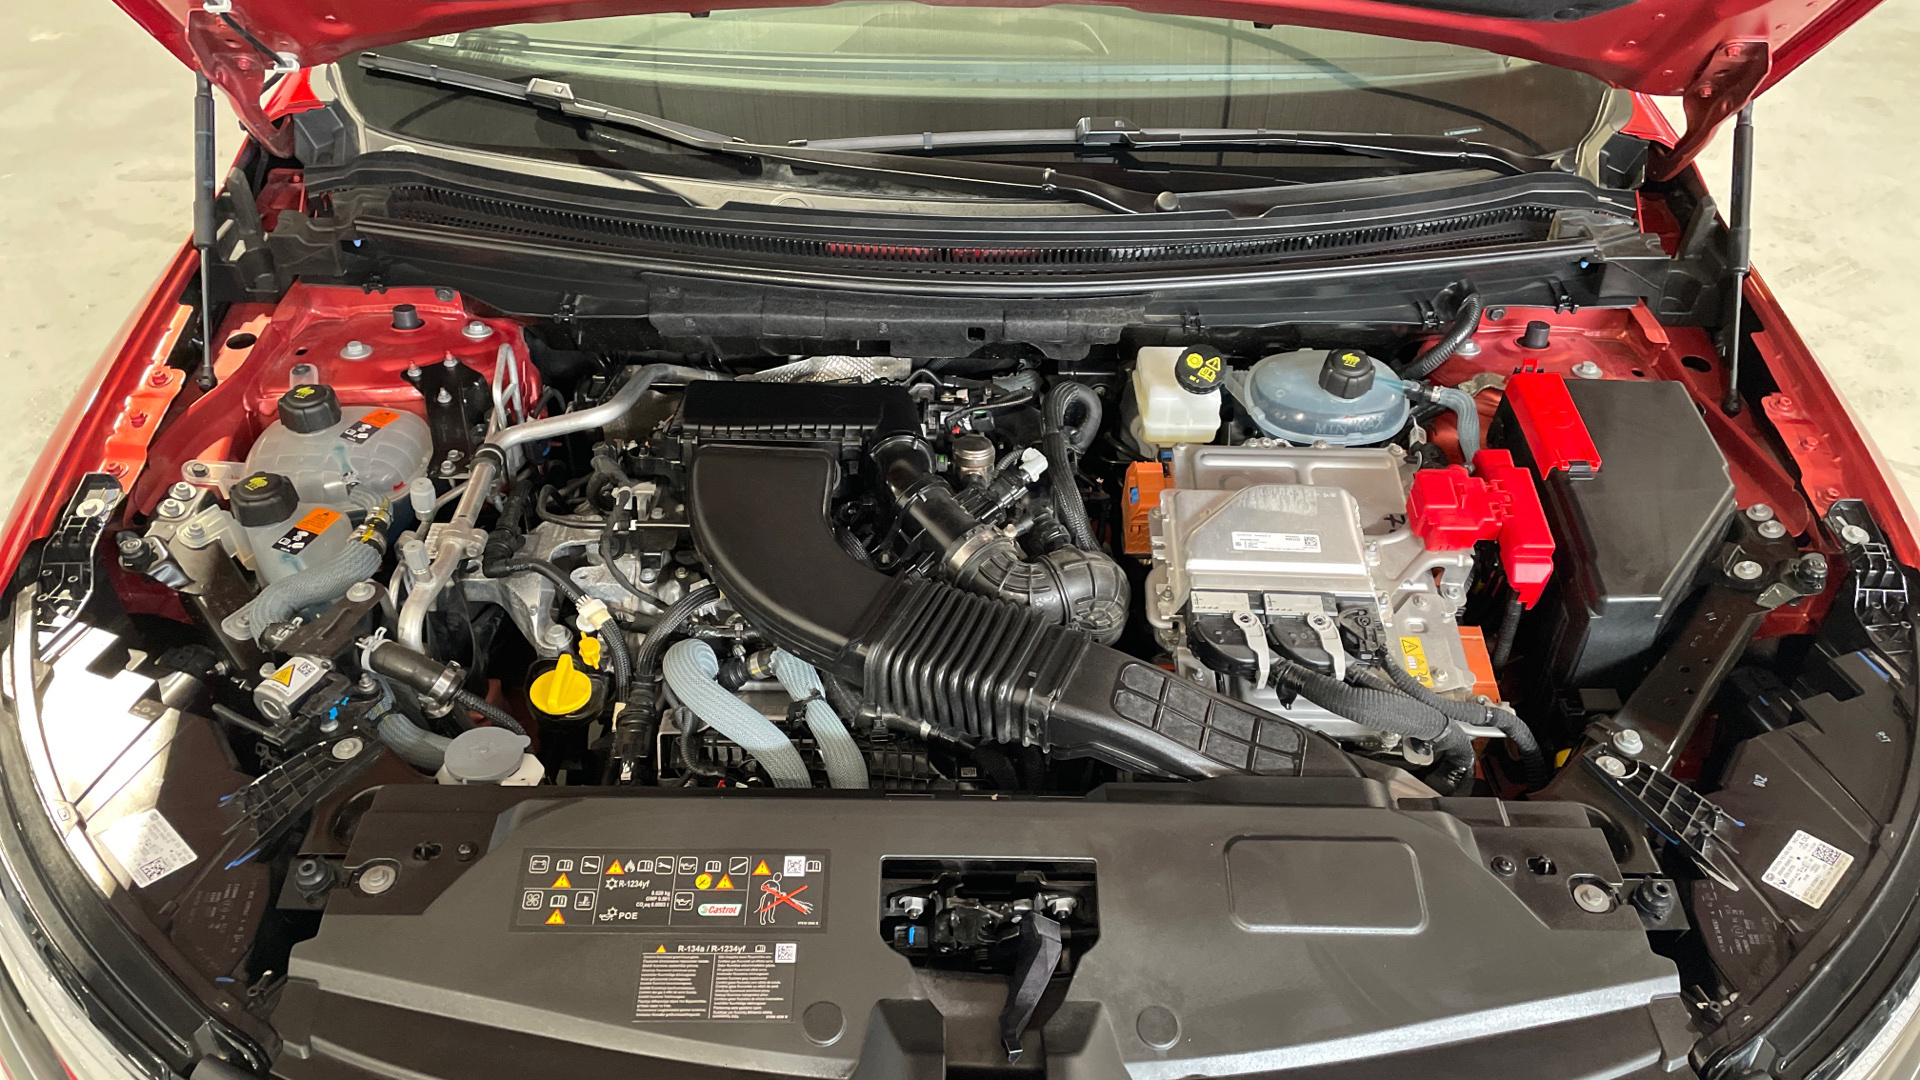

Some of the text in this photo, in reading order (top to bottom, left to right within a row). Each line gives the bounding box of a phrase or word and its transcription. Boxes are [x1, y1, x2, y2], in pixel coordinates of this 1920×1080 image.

[1314, 416, 1384, 434] MIN MAX
[619, 880, 650, 889] R-1234yf
[708, 906, 737, 914] Castrol
[710, 945, 746, 954] R-1234yf
